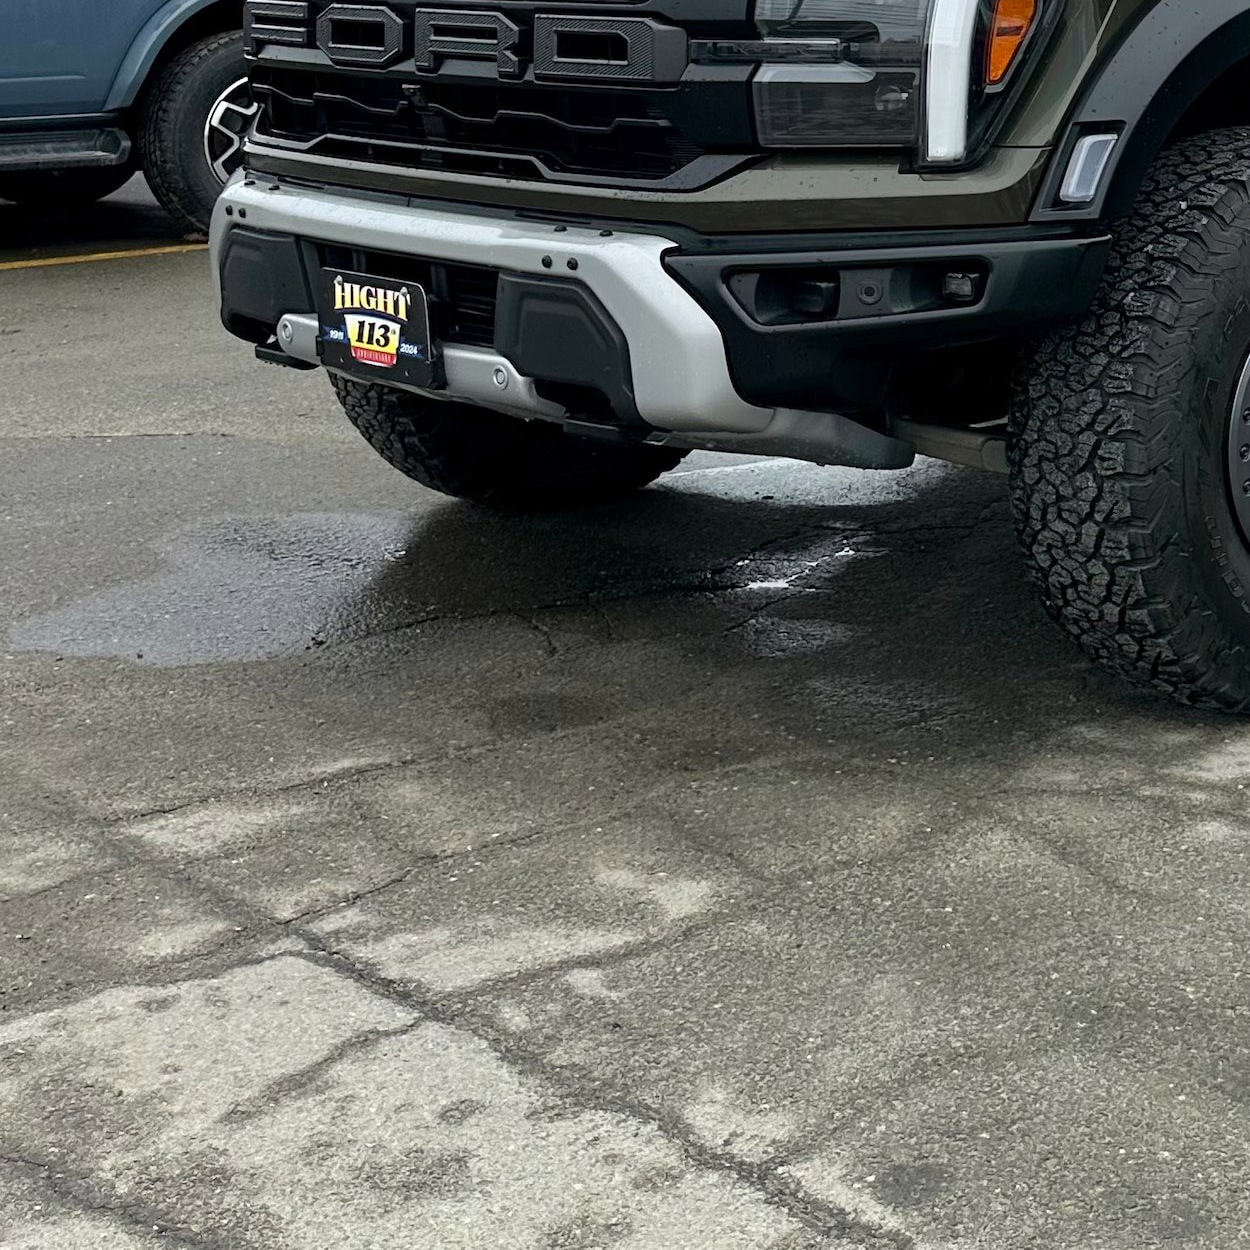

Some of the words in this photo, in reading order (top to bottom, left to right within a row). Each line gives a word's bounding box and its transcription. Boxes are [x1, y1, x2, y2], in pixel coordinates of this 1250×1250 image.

[334, 282, 411, 322] HIGHT
[329, 329, 344, 341] 1911
[400, 343, 419, 355] 2024
